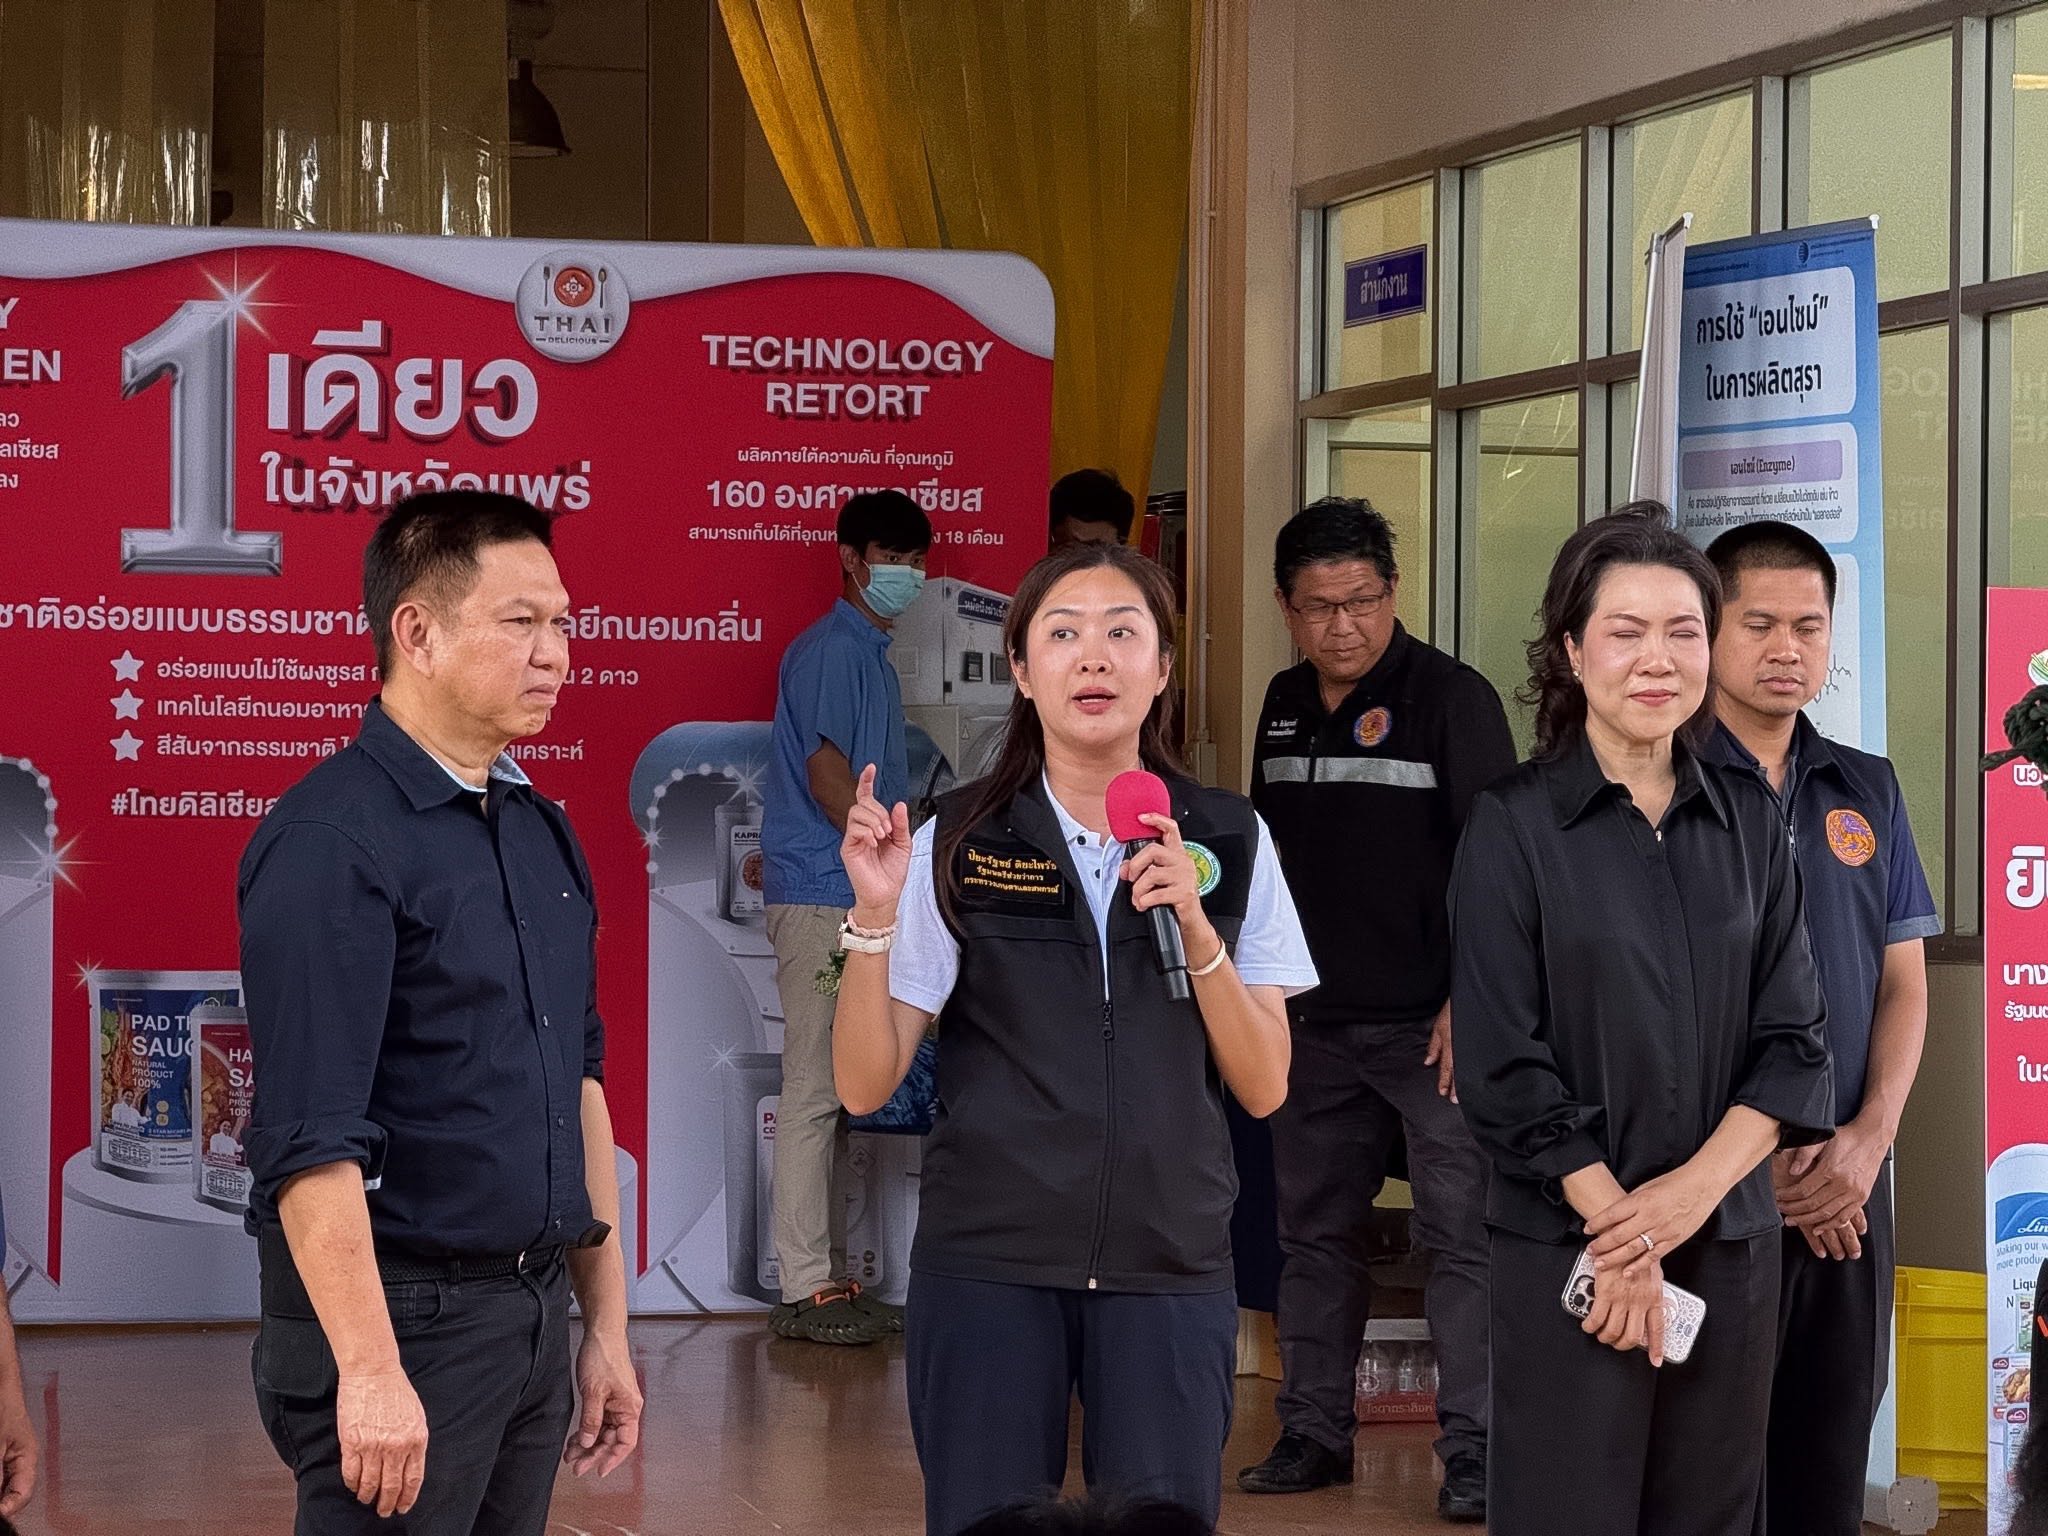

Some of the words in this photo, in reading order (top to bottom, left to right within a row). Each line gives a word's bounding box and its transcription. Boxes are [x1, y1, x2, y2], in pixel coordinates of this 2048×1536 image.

[534, 315, 611, 334] THAI
[1696, 301, 1745, 344] การใช้
[548, 336, 597, 345] DELICIOUS
[702, 335, 995, 372] TECHNOLOGY
[267, 320, 539, 438] เดียว
[1705, 361, 1822, 403] ในการผลิตสุรา
[766, 382, 931, 417] RETORT
[737, 446, 881, 465] ผลิตภายใต้ความดัน
[885, 444, 954, 471] ที่อุณหภูมิ
[706, 480, 766, 508] 160
[946, 531, 964, 544] 18
[968, 528, 1004, 546] เดือน
[157, 656, 366, 688] อร่อยแบบไม่ใช้ผงชูรส
[580, 668, 593, 685] 2
[600, 670, 639, 685] ดาว
[157, 695, 370, 718] เทคโนโลยีถนอมอาหา
[131, 1014, 171, 1031] PAD
[132, 1060, 167, 1070] NATURAL
[132, 1067, 174, 1079] PRODUCT
[132, 1078, 161, 1090] 100%
[2024, 1242, 2039, 1251] our
